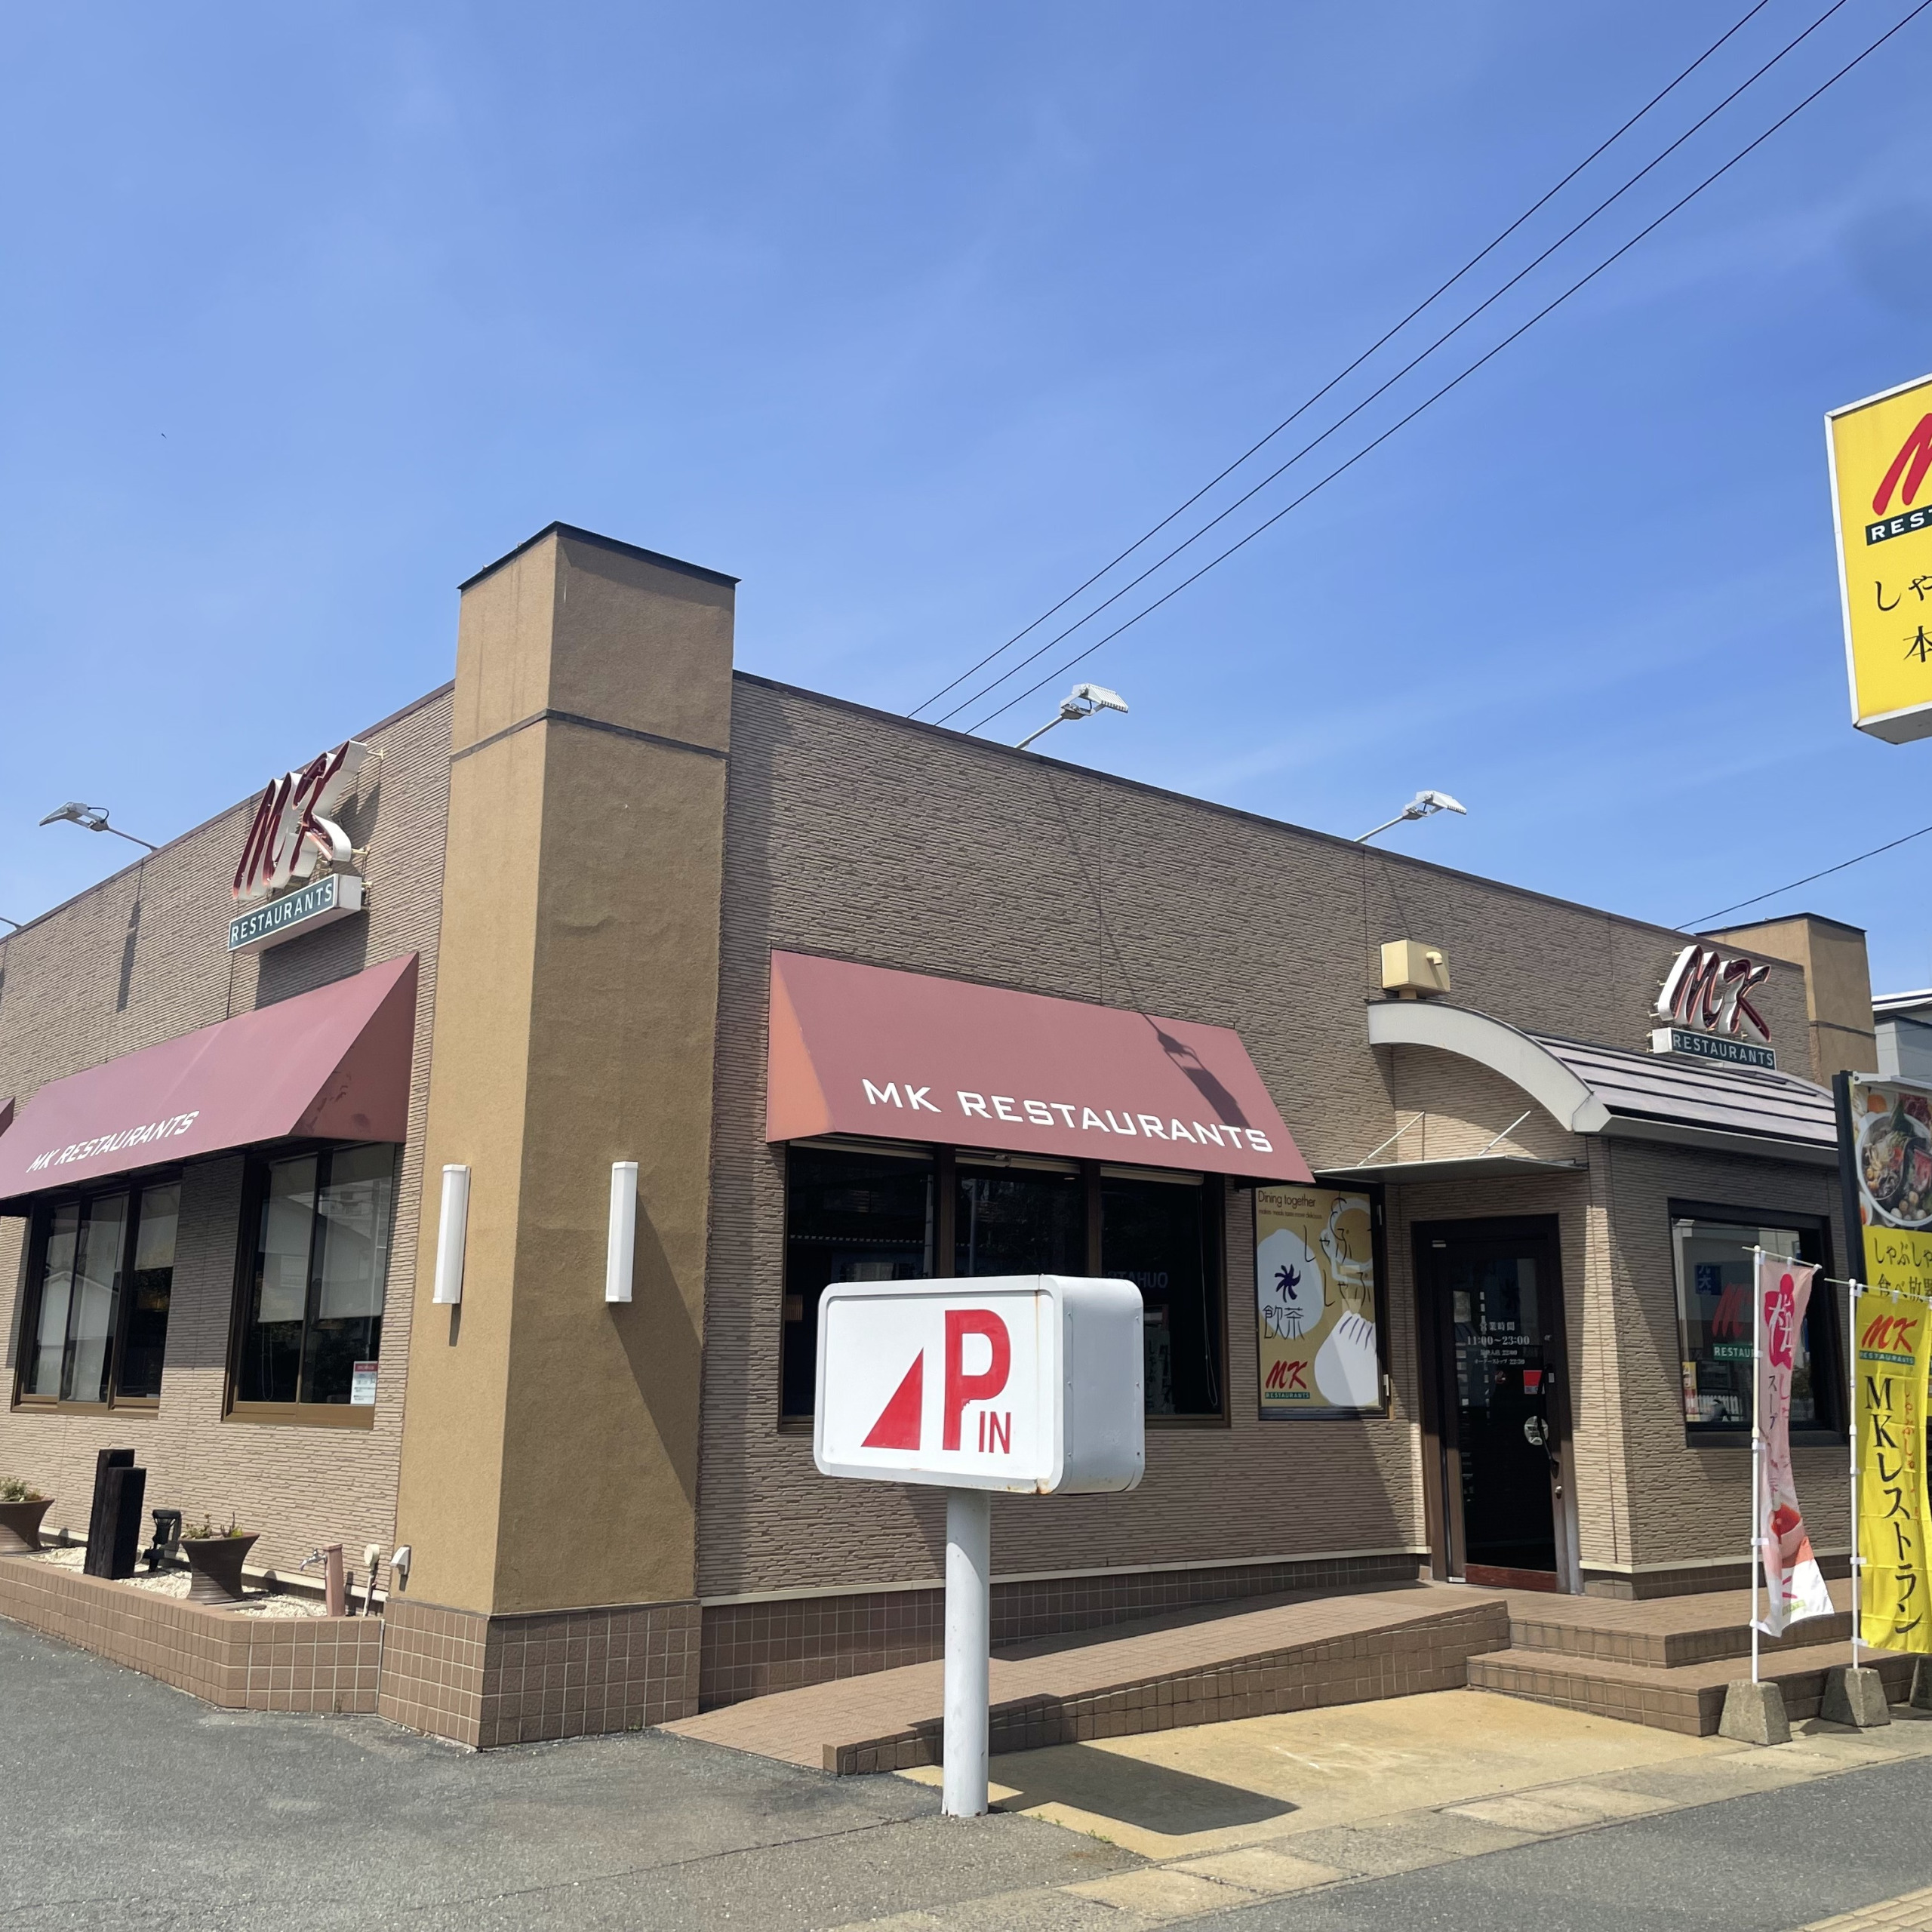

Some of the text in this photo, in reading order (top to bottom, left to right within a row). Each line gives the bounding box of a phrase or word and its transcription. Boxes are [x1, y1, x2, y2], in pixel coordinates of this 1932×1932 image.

[1872, 507, 1932, 540] RES
[232, 740, 353, 900] MK
[230, 882, 333, 943] RESTAURANTS
[1665, 944, 1771, 1043] MK
[1673, 1033, 1774, 1066] RESTAURANTS
[26, 1110, 199, 1173] MK RESTAURANTS
[862, 1078, 1273, 1153] MK RESTAURANTS
[1258, 1190, 1316, 1209] Dining together
[1263, 1305, 1305, 1341] 飲茶
[1861, 1314, 1918, 1353] MK
[943, 1309, 1011, 1454] P IN
[1265, 1360, 1308, 1389] MK
[1768, 1375, 1778, 1430] スープ
[1864, 1376, 1922, 1633] MKレストラン
